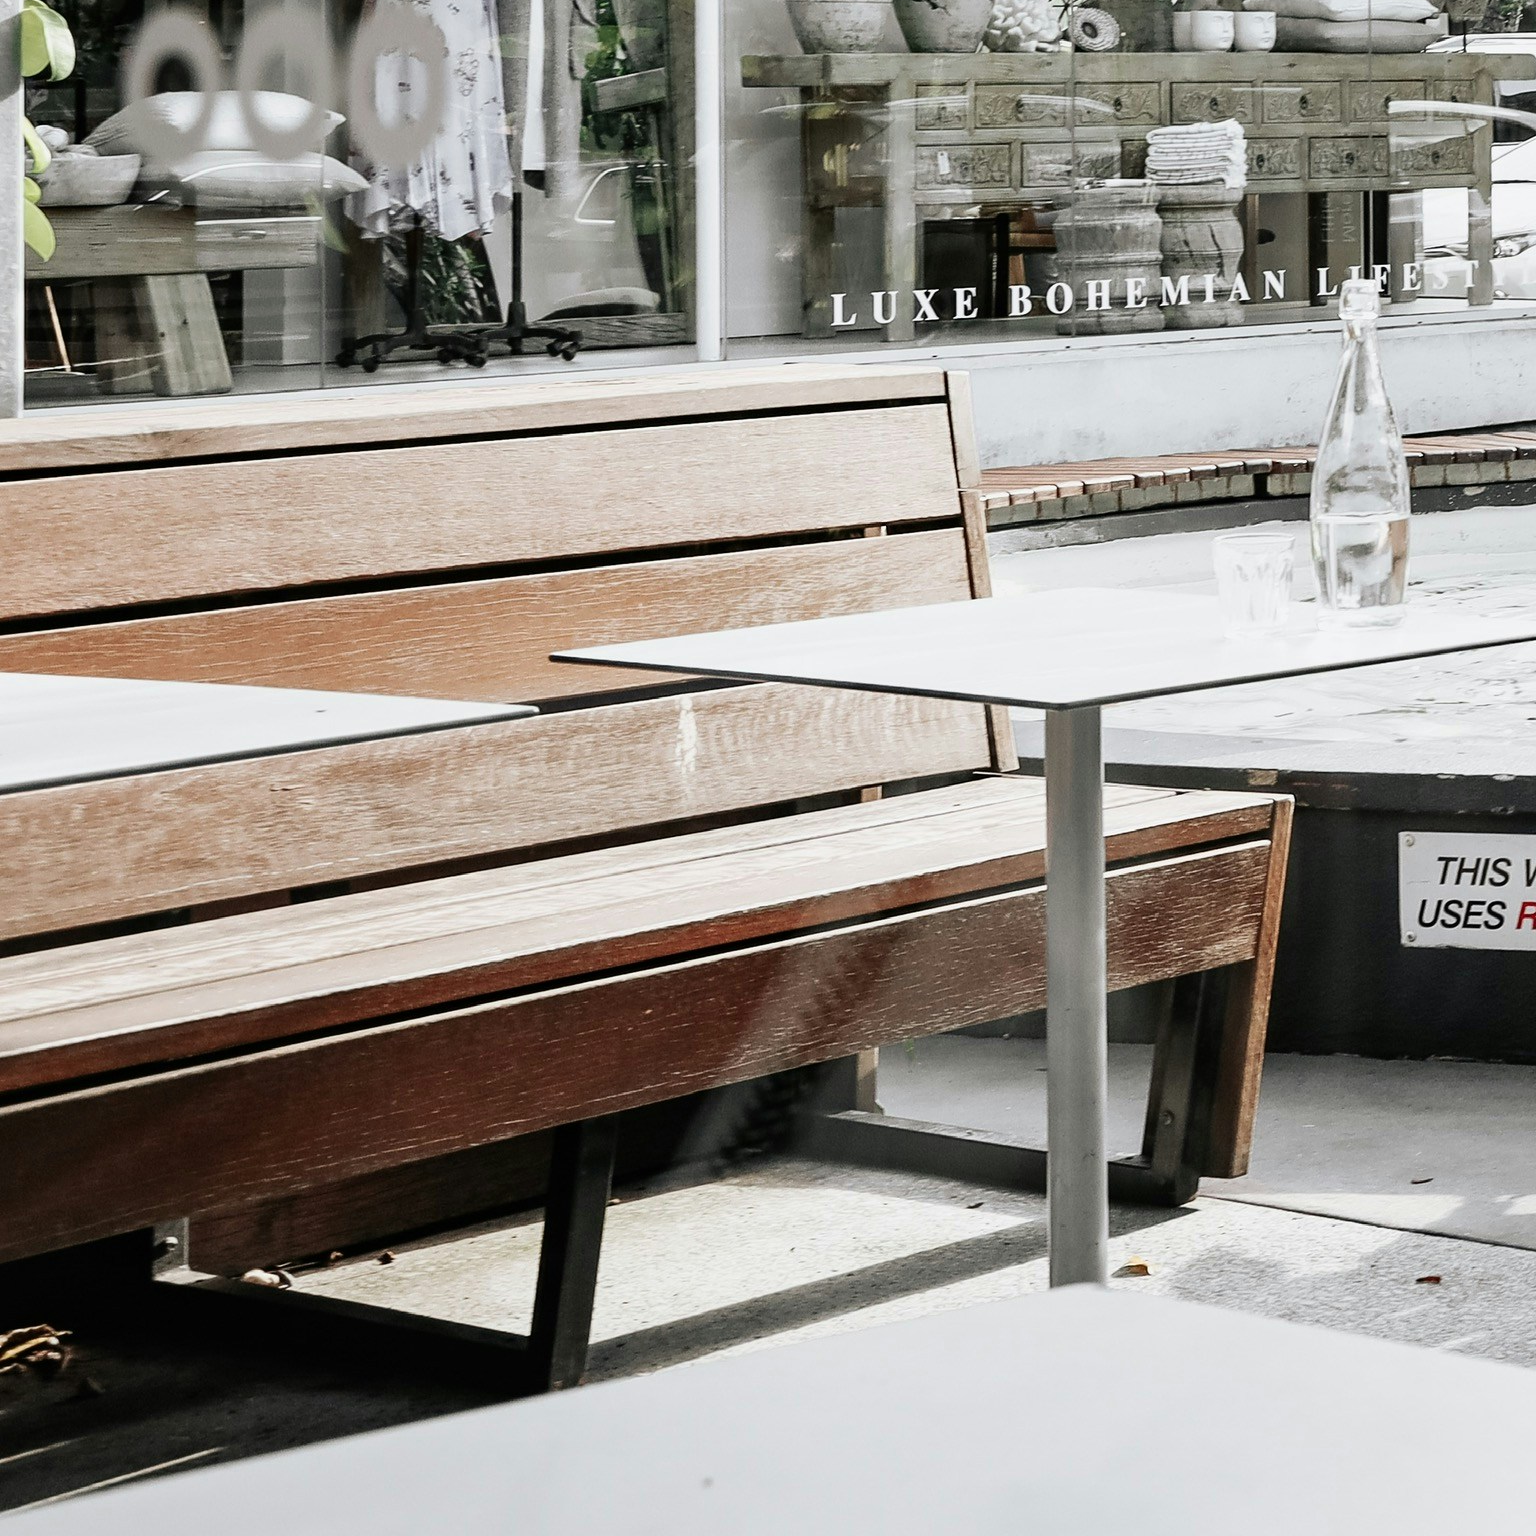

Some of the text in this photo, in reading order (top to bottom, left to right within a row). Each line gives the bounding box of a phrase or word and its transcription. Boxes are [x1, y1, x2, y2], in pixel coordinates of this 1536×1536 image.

[830, 285, 979, 327] LUXE
[1008, 269, 1287, 318] BOHEMIAN
[1437, 856, 1512, 887] THIS
[1418, 899, 1507, 930] USES
